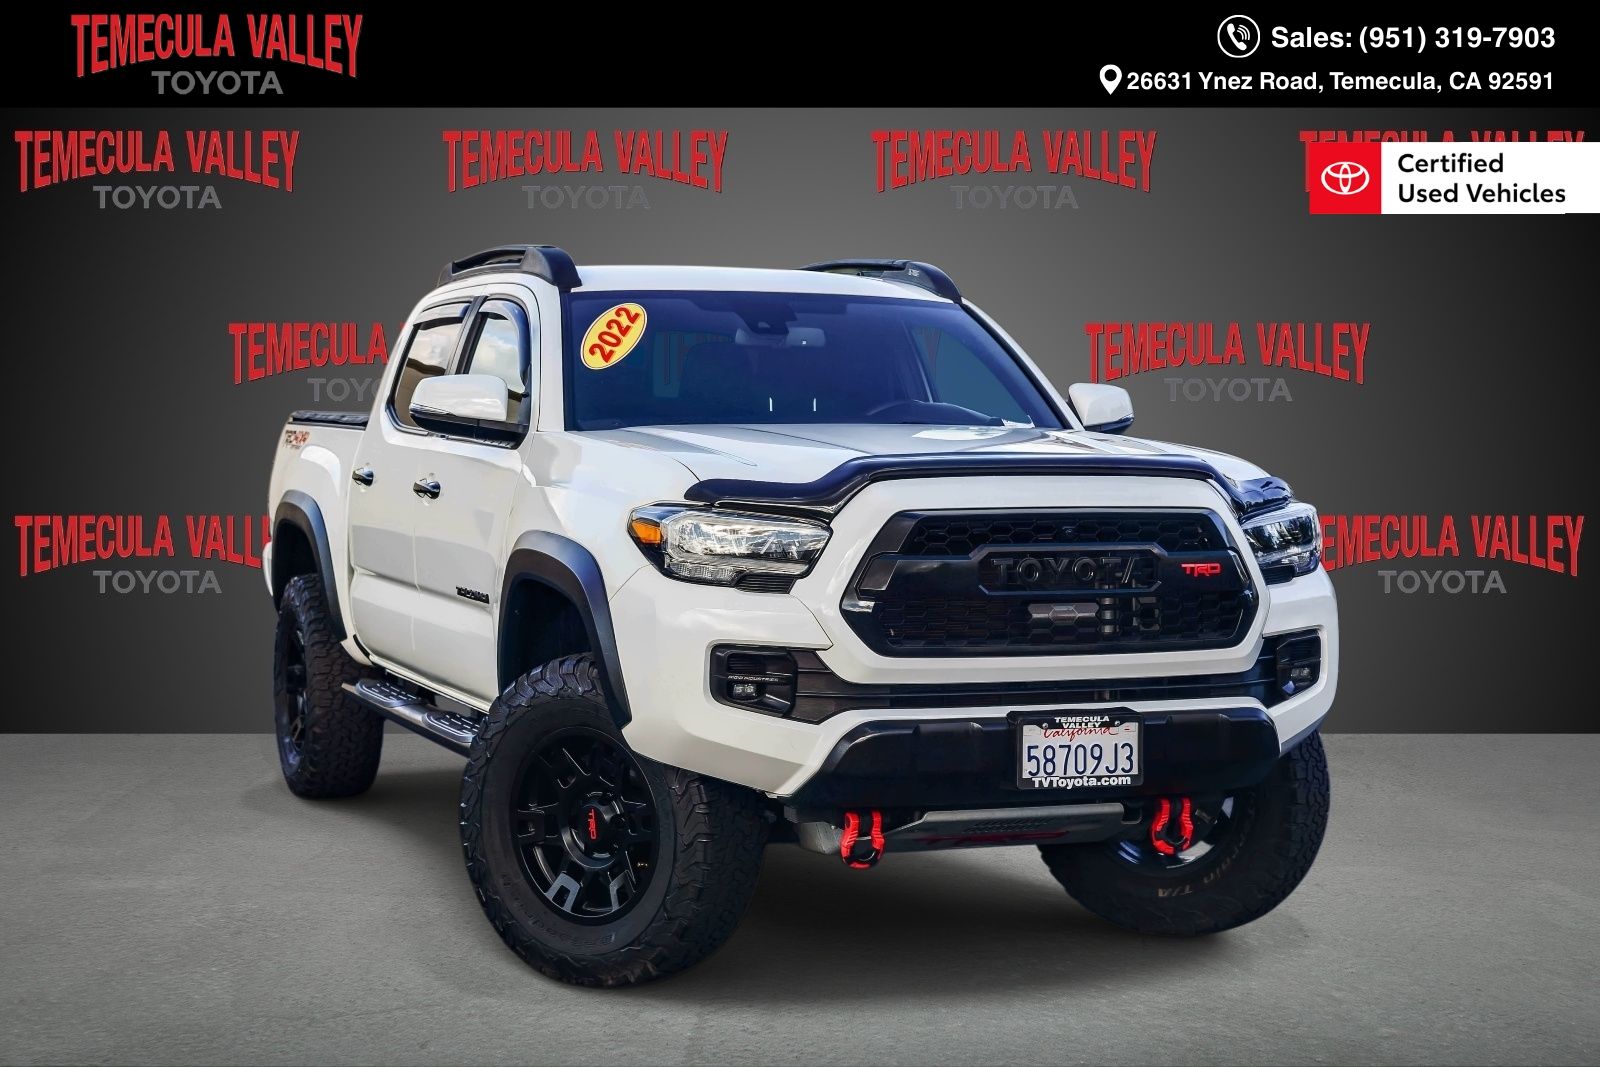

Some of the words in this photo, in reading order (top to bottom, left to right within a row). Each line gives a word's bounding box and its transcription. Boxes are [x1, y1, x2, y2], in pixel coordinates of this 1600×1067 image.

[14, 130, 175, 193] TEMECULA
[185, 130, 300, 193] VALLEY
[442, 130, 603, 193] TEMECULA
[614, 130, 728, 193] VALLEY
[871, 130, 1032, 193] TEMECULA
[1042, 130, 1157, 193] VALLEY
[93, 186, 222, 209] TOYOTA
[522, 186, 651, 209] TOYOTA
[951, 186, 1080, 209] TOYOTA
[588, 306, 641, 364] 2022
[228, 322, 389, 385] TEMECULA
[1084, 322, 1245, 385] TEMECULA
[1256, 322, 1371, 385] VALLEY
[307, 378, 382, 402] TOY
[1164, 378, 1293, 402] TOYOTA
[14, 514, 175, 577] TEMECULA
[185, 515, 270, 568] VALL
[1319, 515, 1460, 572] EMECULA
[1471, 515, 1584, 577] VALLEY
[93, 570, 222, 594] TOYOTA
[1180, 562, 1222, 578] TRD
[1378, 570, 1507, 594] TOYOTA
[1054, 715, 1110, 724] TEMECULA
[1026, 742, 1134, 777] 58709J3
[1032, 775, 1131, 790] TVToyota.com
[587, 808, 597, 840] TRD
